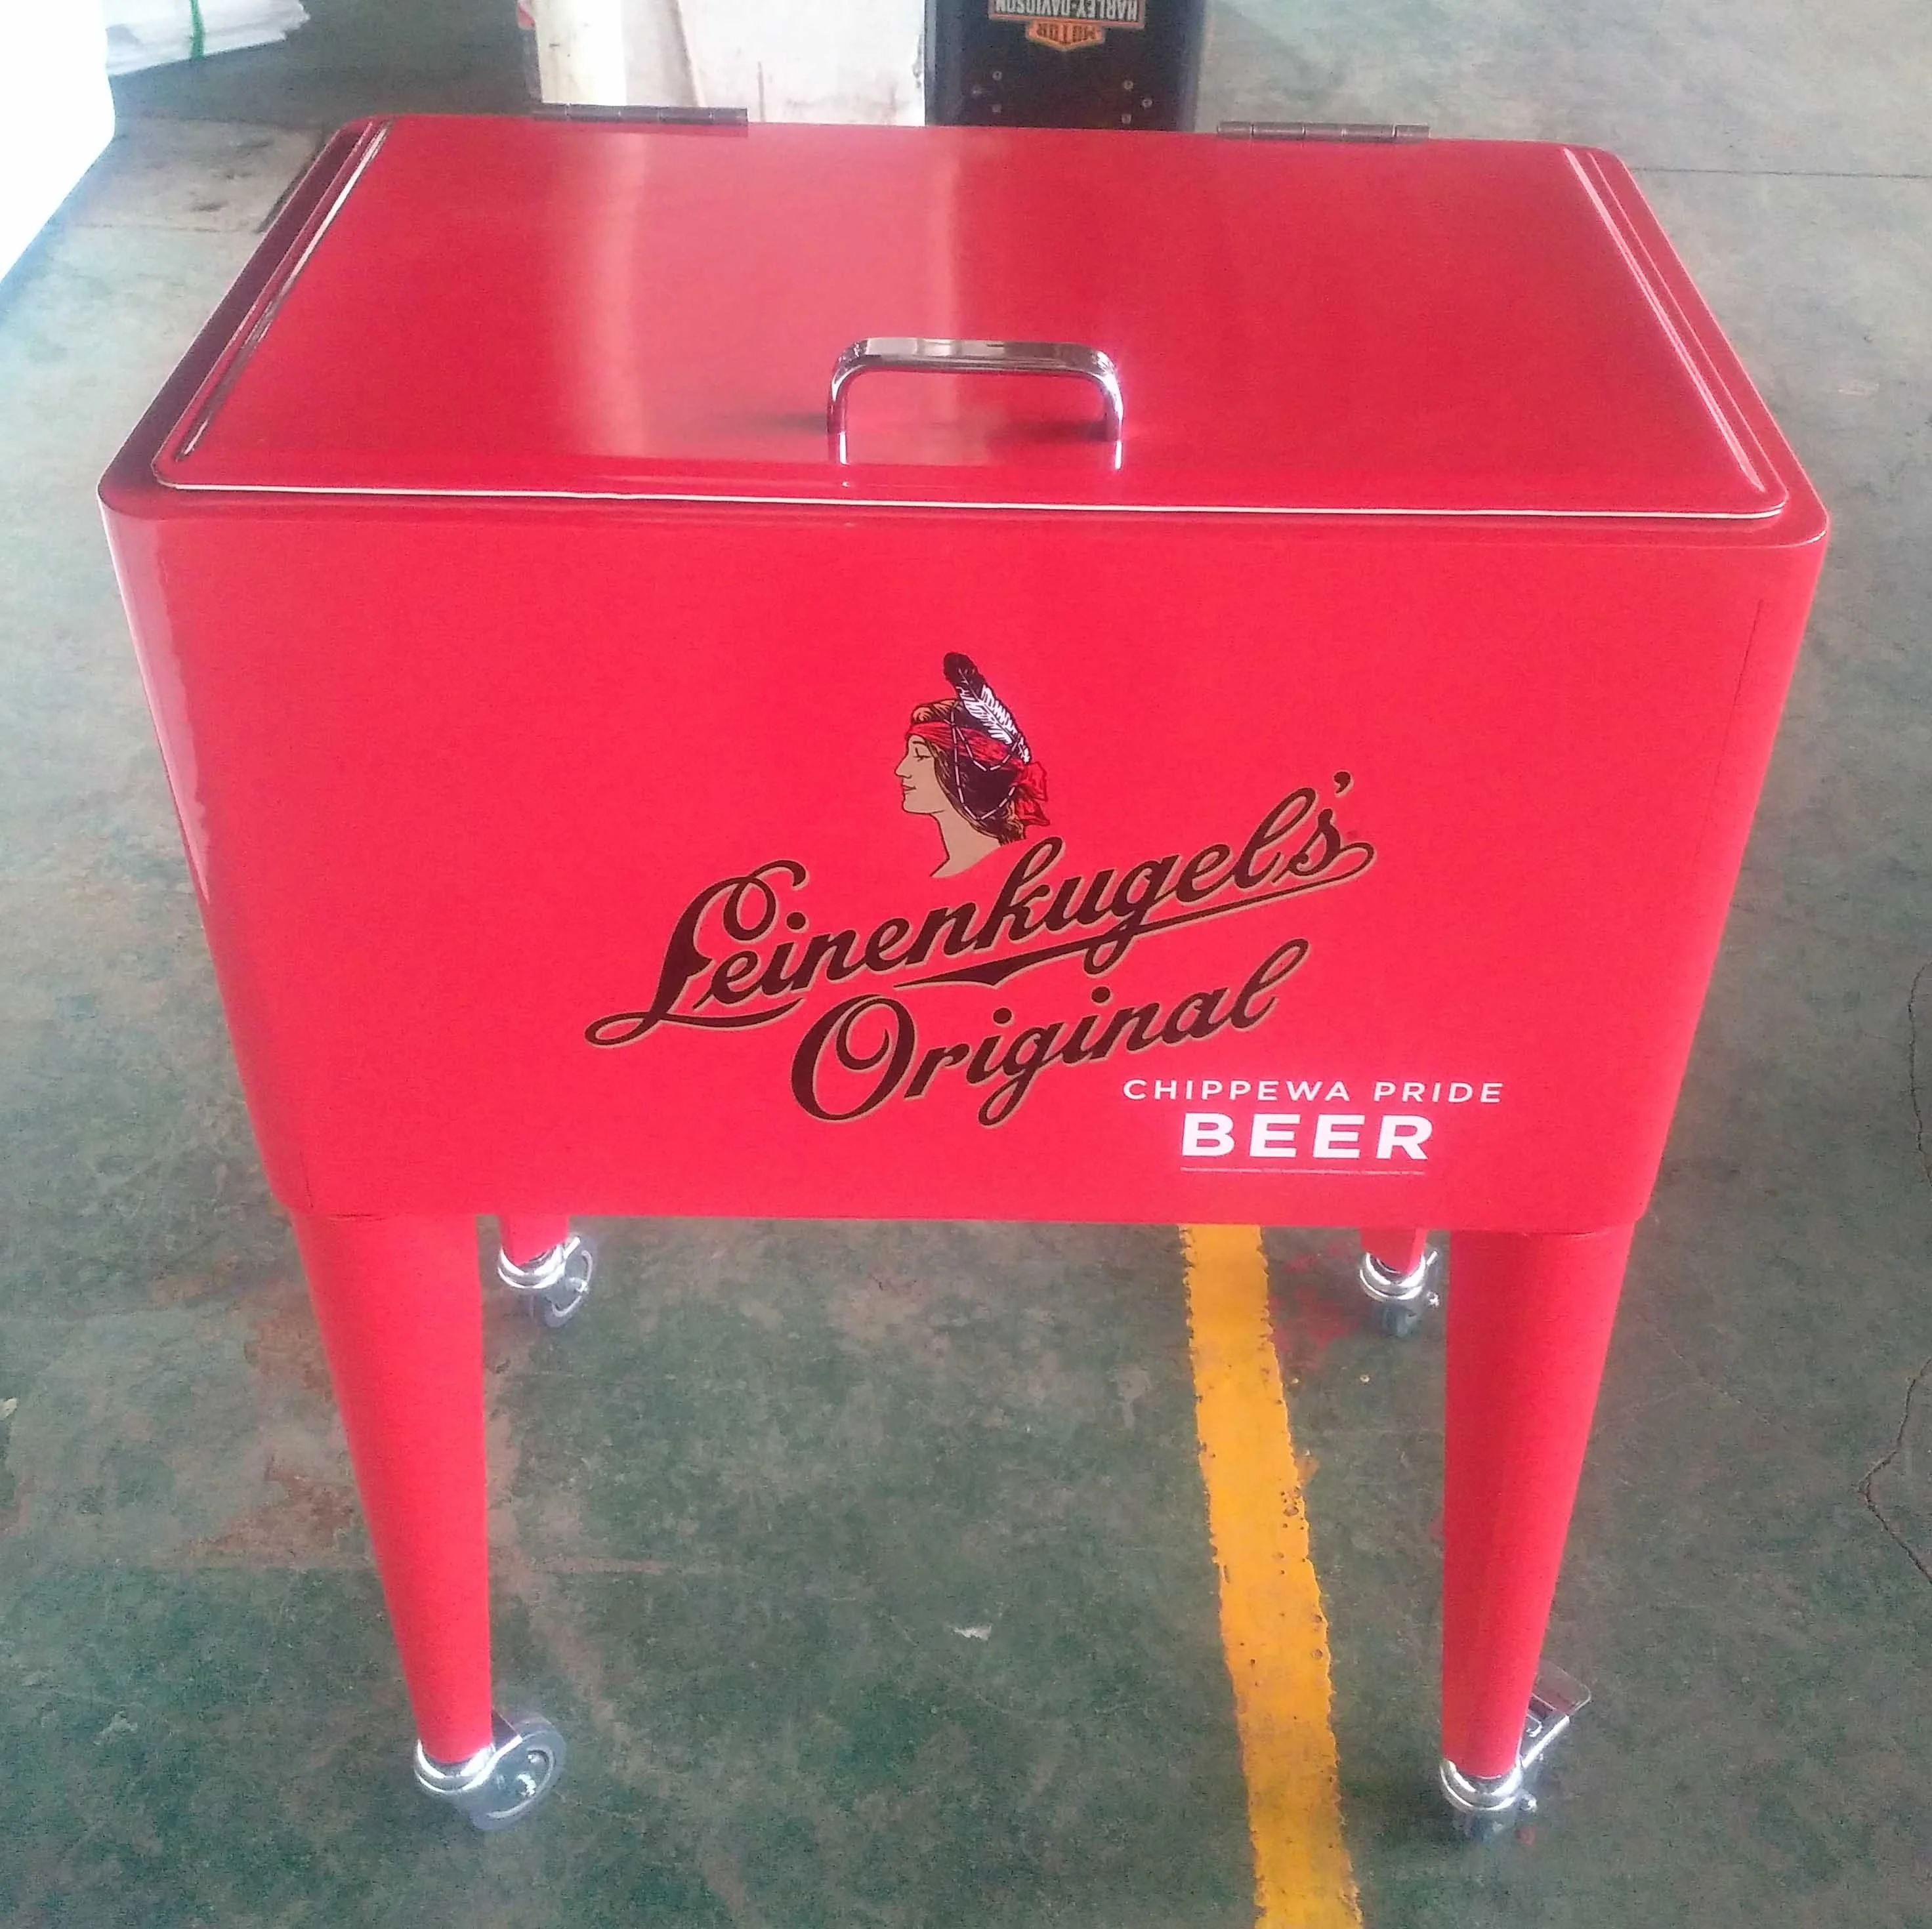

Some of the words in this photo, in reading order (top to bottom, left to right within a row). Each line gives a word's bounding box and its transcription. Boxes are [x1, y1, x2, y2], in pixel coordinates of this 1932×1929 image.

[584, 770, 1377, 1048] Leinenkugel's
[791, 938, 1310, 1128] Original
[1122, 1079, 1351, 1102] CHIPPEWA
[1373, 1081, 1503, 1104] PRIDE
[1181, 1112, 1433, 1161] BEER
